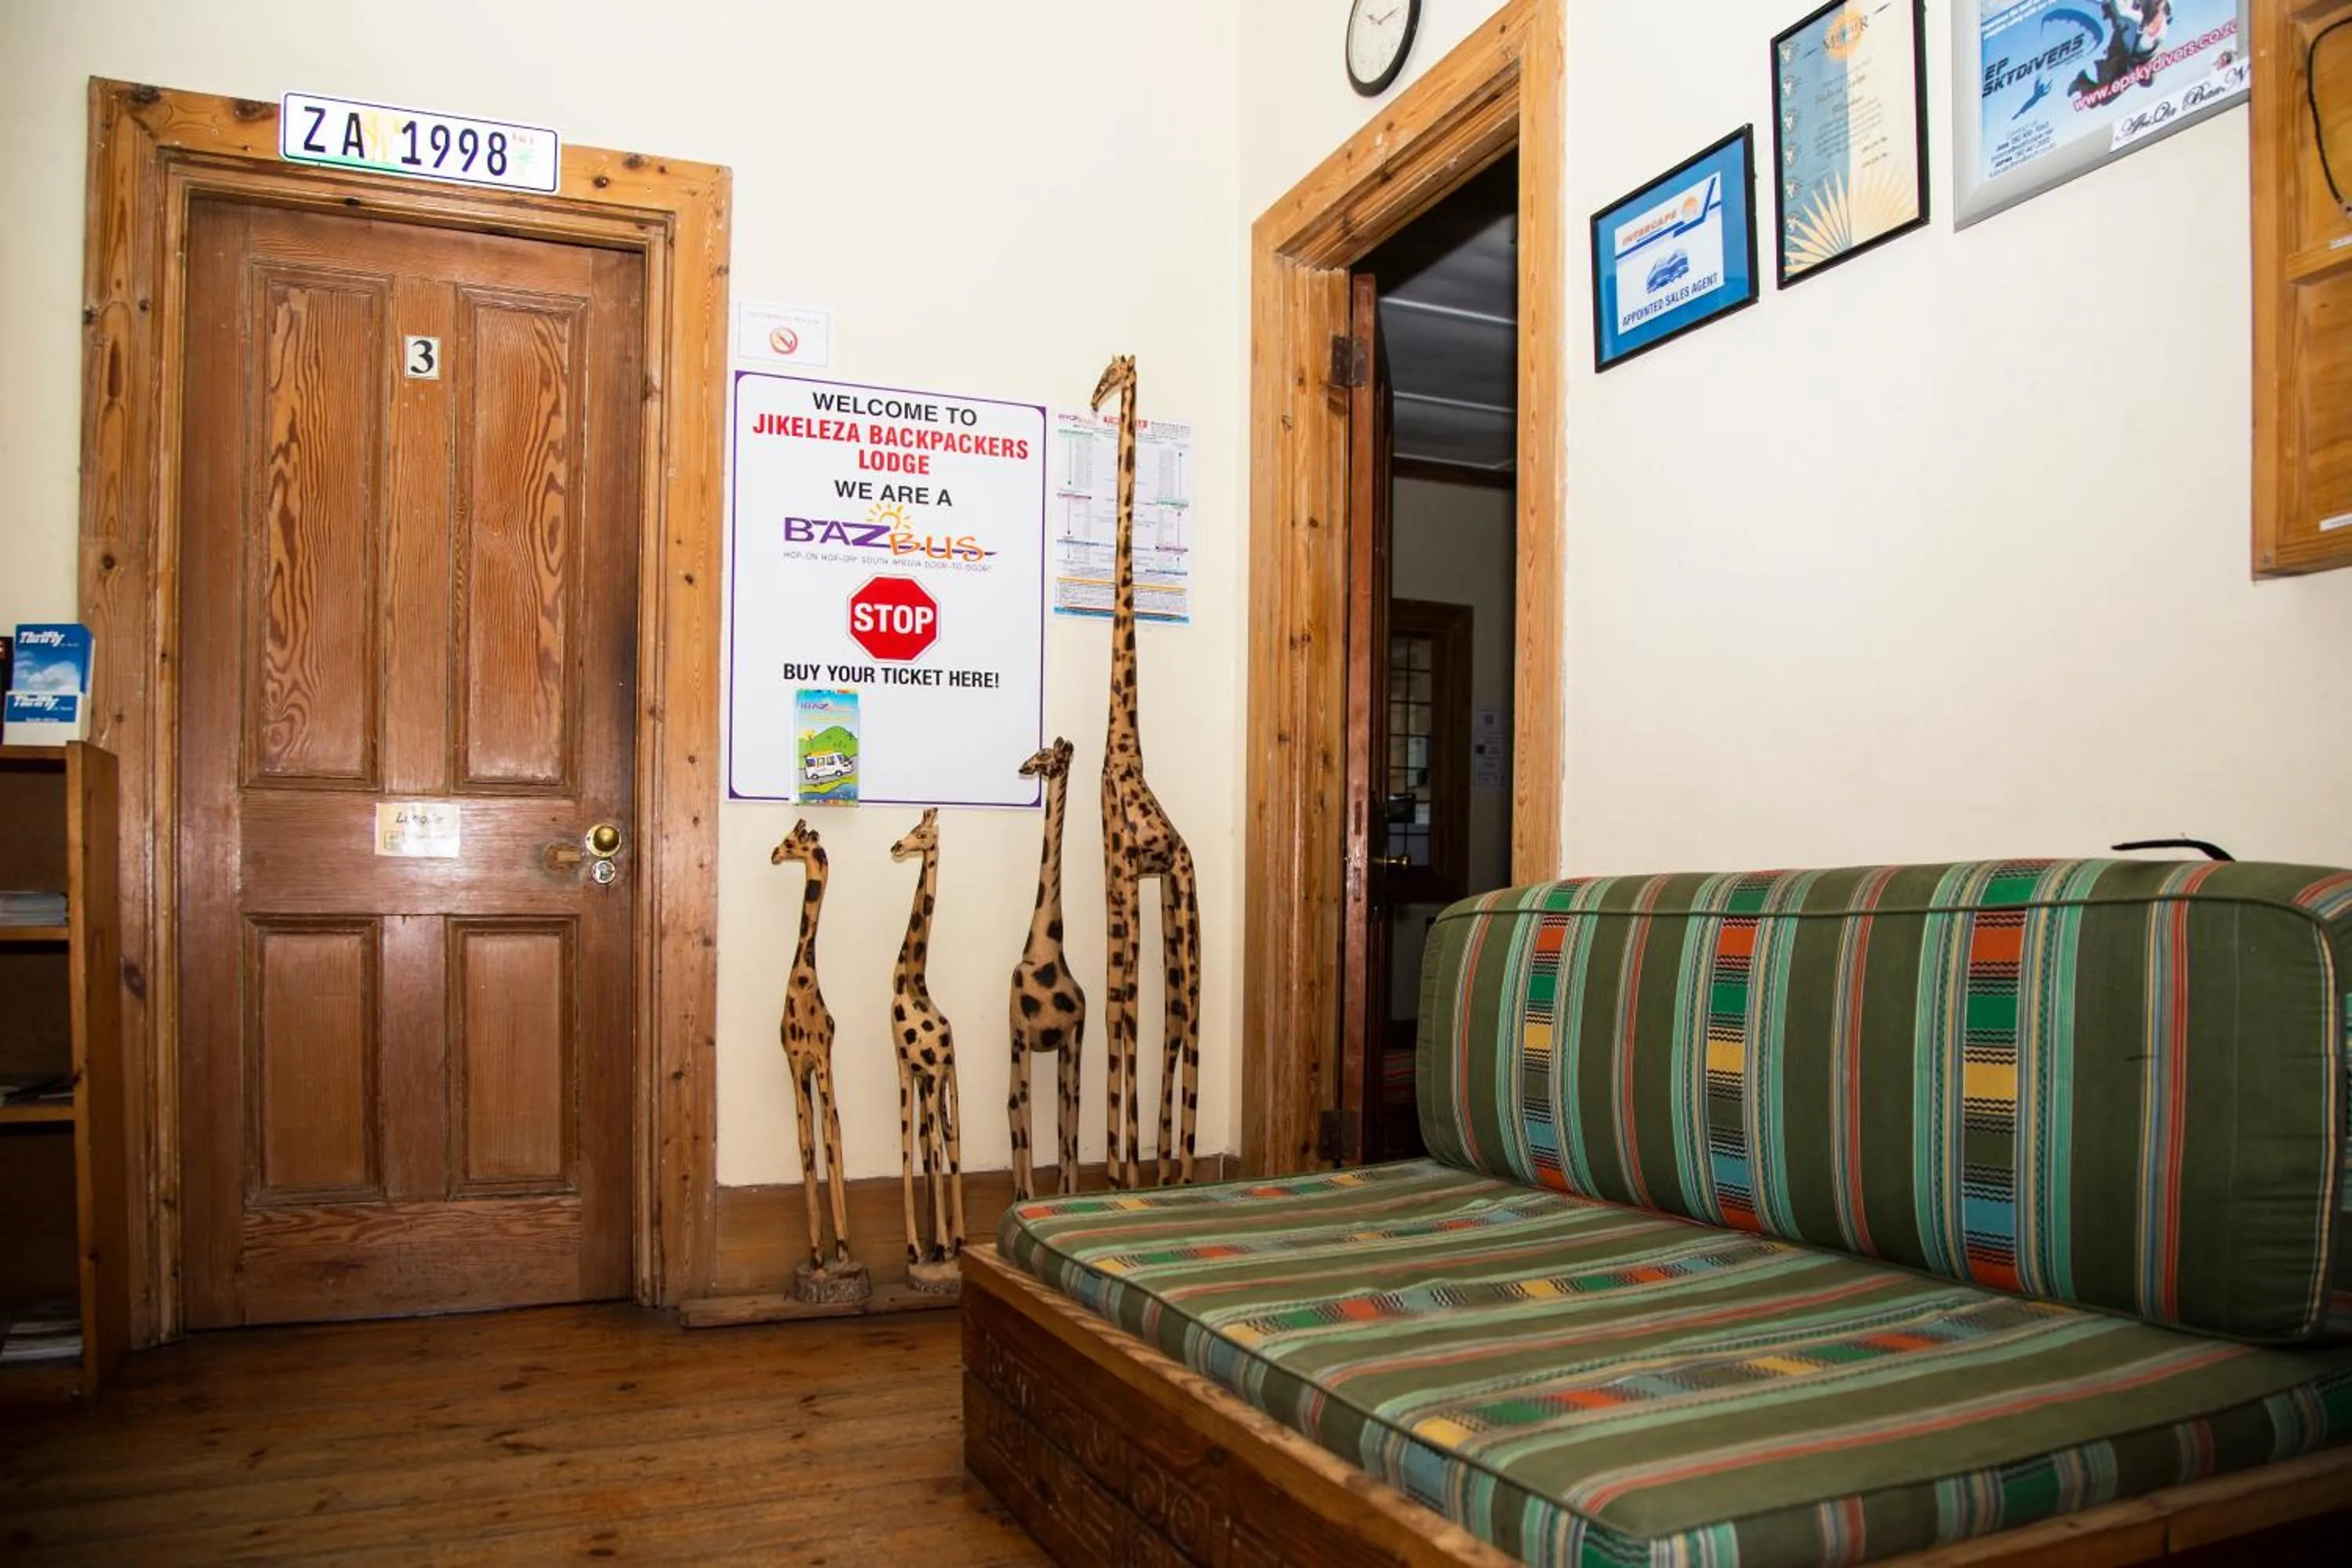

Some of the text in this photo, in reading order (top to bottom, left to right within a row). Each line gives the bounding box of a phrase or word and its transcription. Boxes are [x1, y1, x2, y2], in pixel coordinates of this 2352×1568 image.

[1984, 56, 2009, 81] EP
[303, 106, 507, 176] ZA 1998
[1622, 272, 1719, 327] APPOINTED SALES AGENT
[410, 339, 434, 373] 3
[812, 392, 978, 426] WELCOME TO
[753, 413, 861, 443] JIKELEZA
[869, 425, 1029, 460] BACKPACKERS
[858, 449, 930, 475] LODGE
[834, 480, 953, 506] WE ARE A
[784, 517, 891, 547] BAZ
[854, 603, 934, 634] STOP
[783, 664, 1000, 688] BUY YOUR TICKET HERE!
